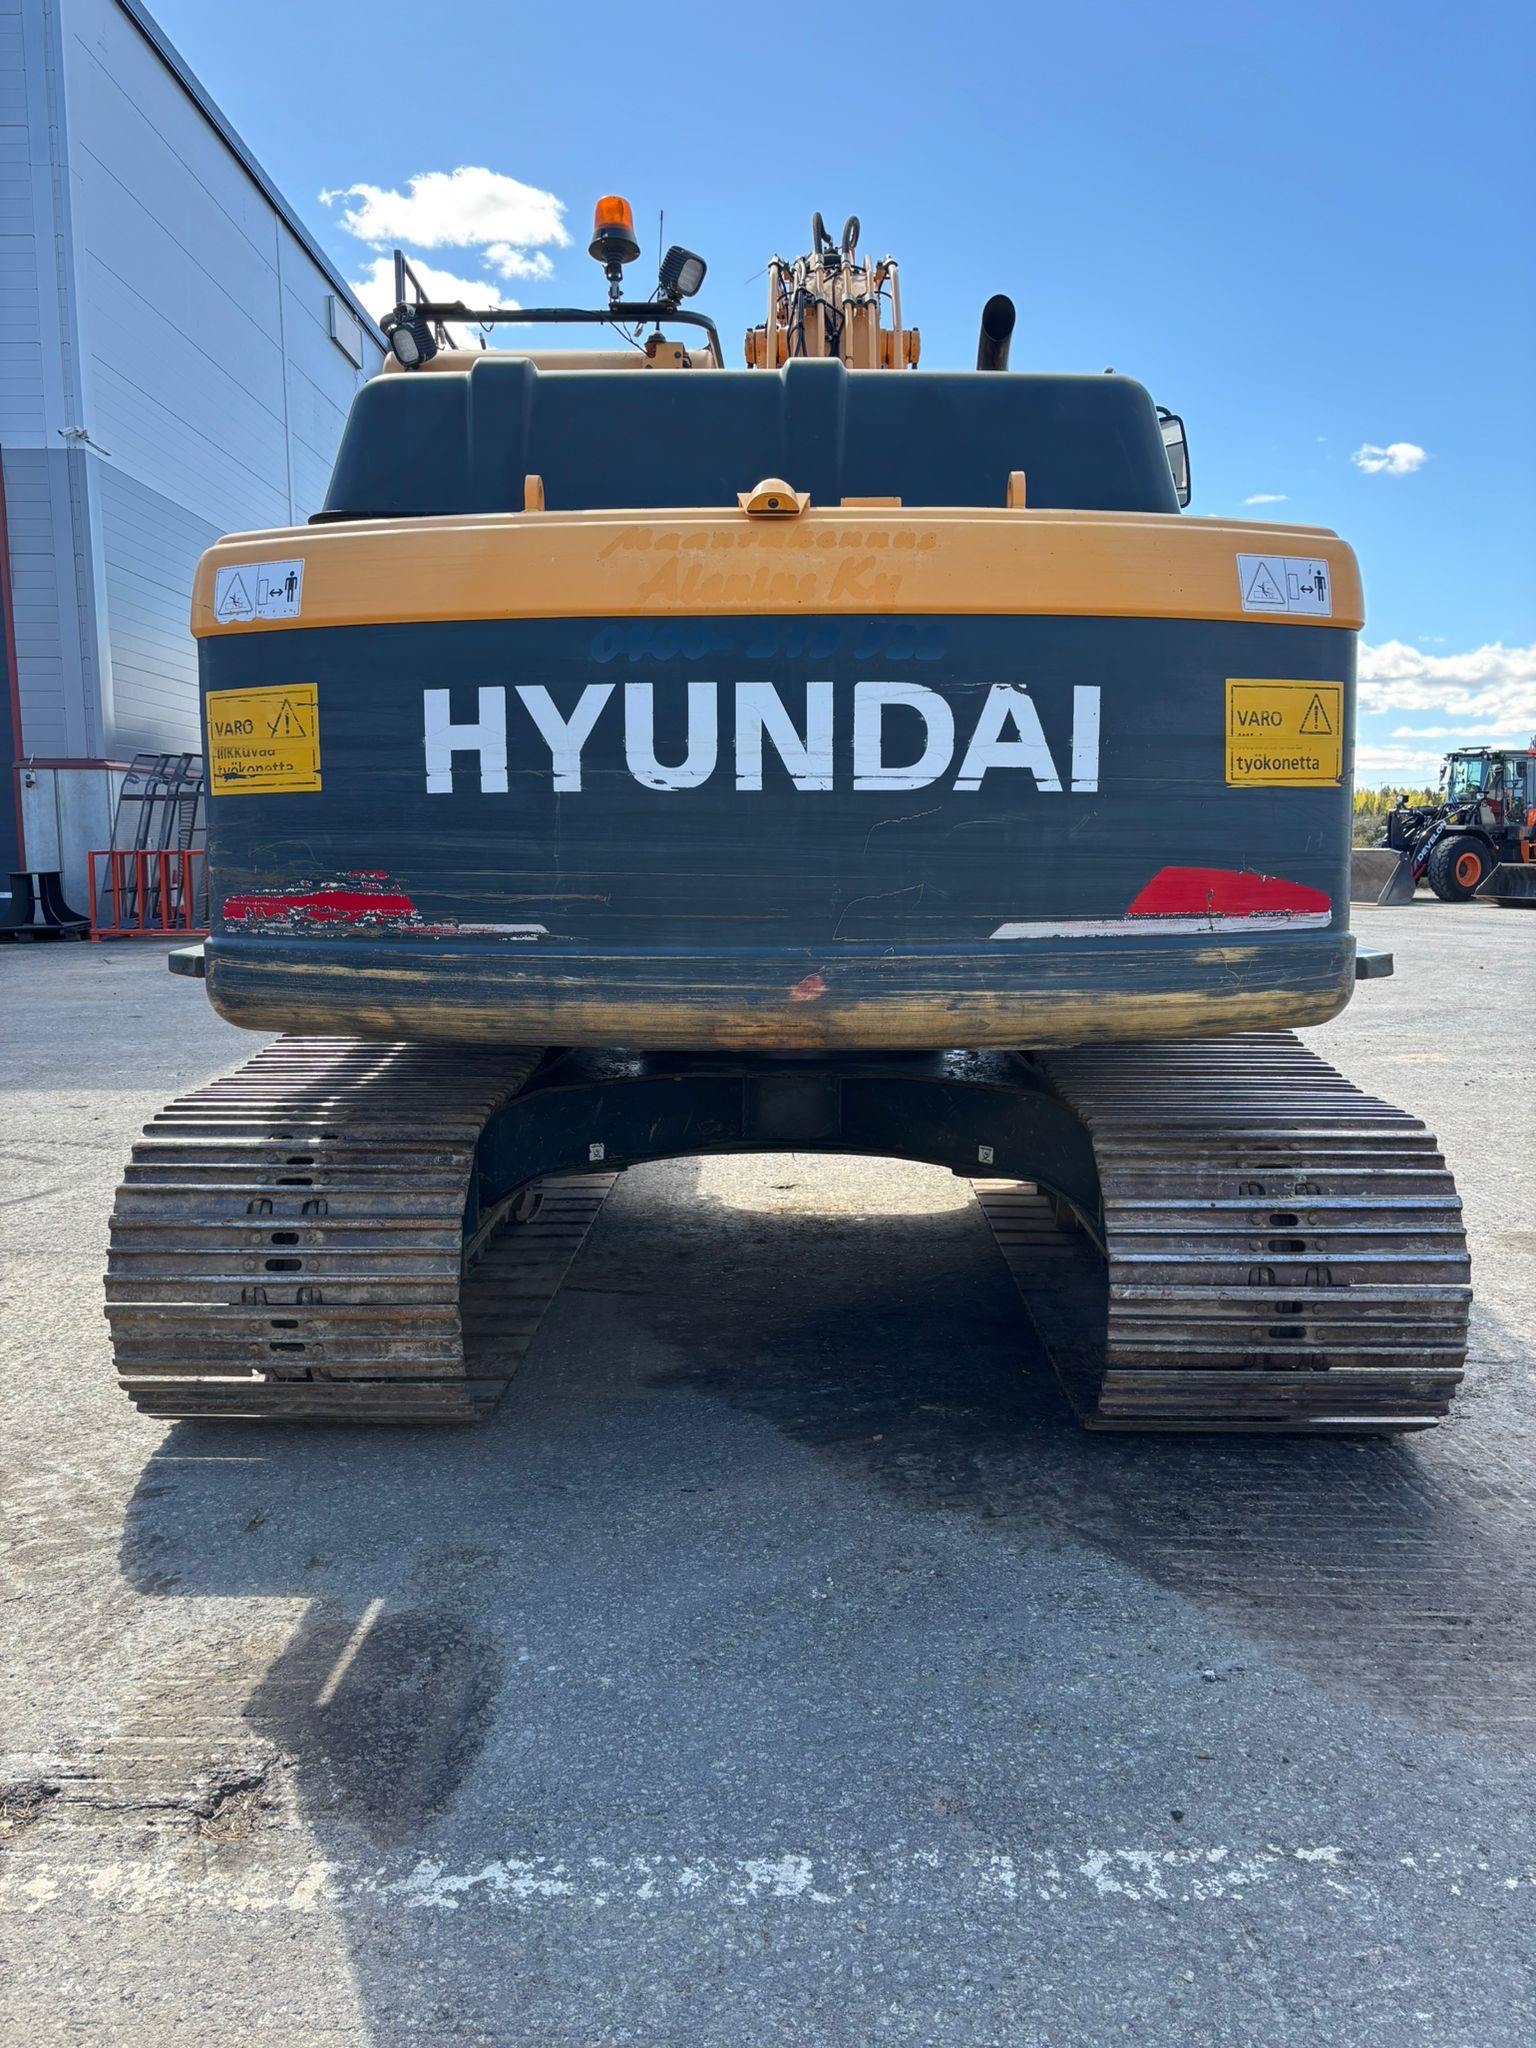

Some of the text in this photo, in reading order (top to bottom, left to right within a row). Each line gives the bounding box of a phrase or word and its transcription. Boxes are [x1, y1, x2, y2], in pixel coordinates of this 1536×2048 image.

[215, 719, 254, 736] VARO
[1237, 709, 1283, 727] VARO
[423, 681, 1101, 794] HYUNDAI
[1236, 752, 1320, 775] työkonetta
[1416, 819, 1447, 862] DEVELON
